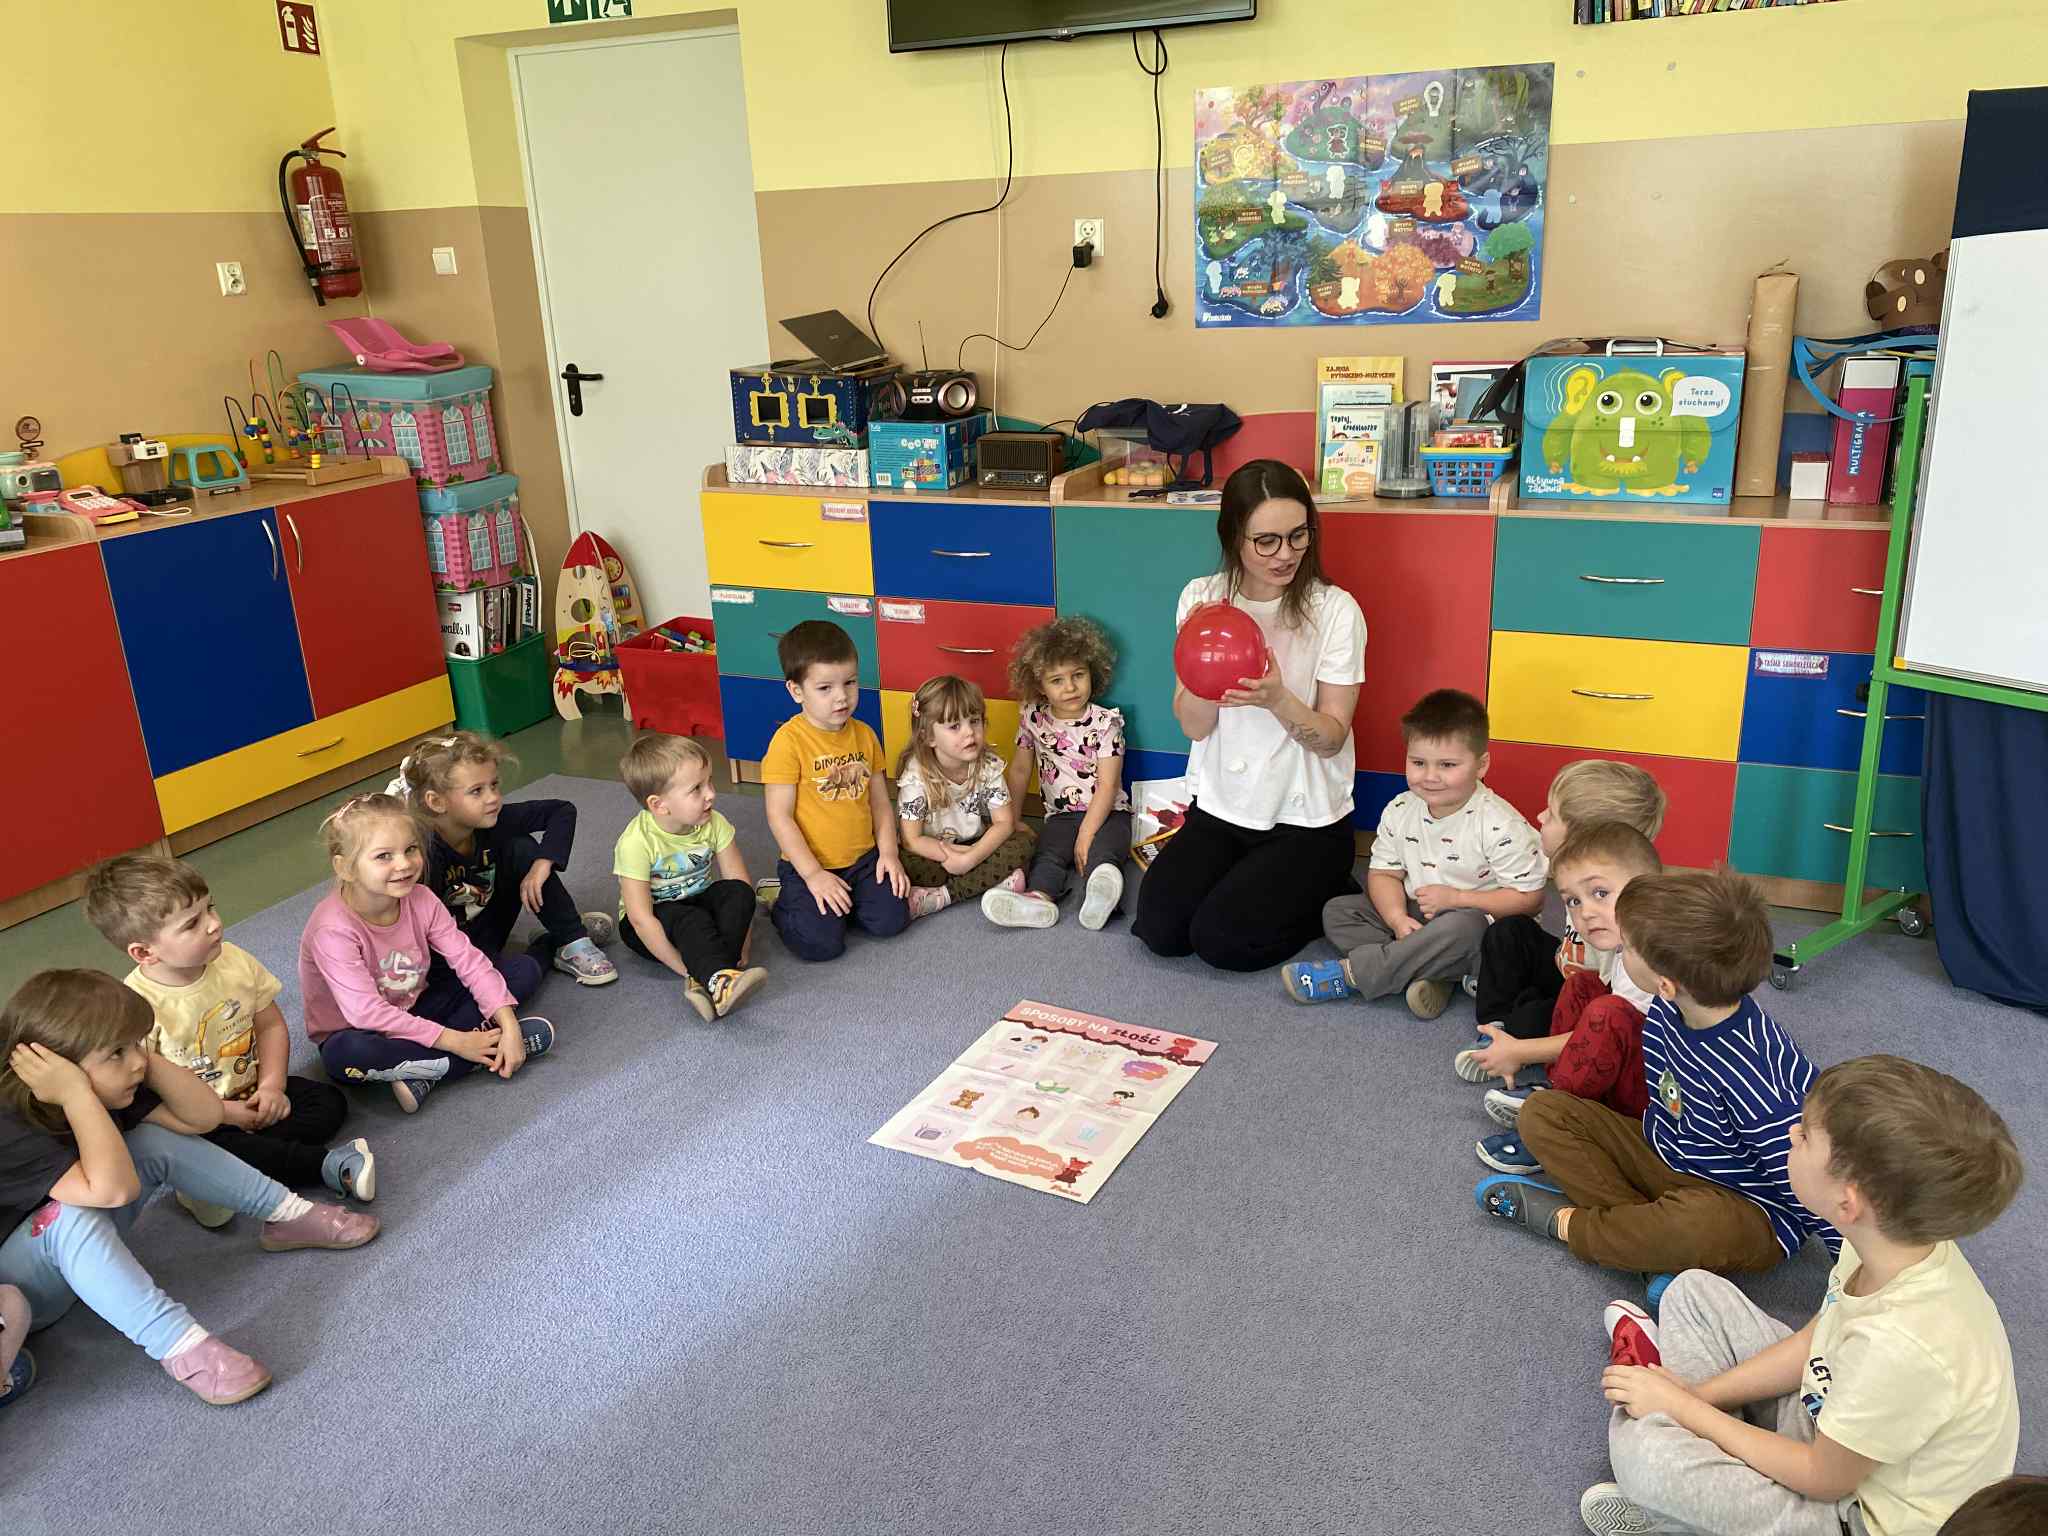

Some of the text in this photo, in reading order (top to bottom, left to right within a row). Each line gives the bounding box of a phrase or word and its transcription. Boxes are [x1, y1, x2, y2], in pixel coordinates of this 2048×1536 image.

[1690, 387, 1714, 396] Teraz
[814, 751, 867, 772] DINOSAUR
[1020, 1006, 1162, 1046] SPOSOBY NA ZŁOŚĆ
